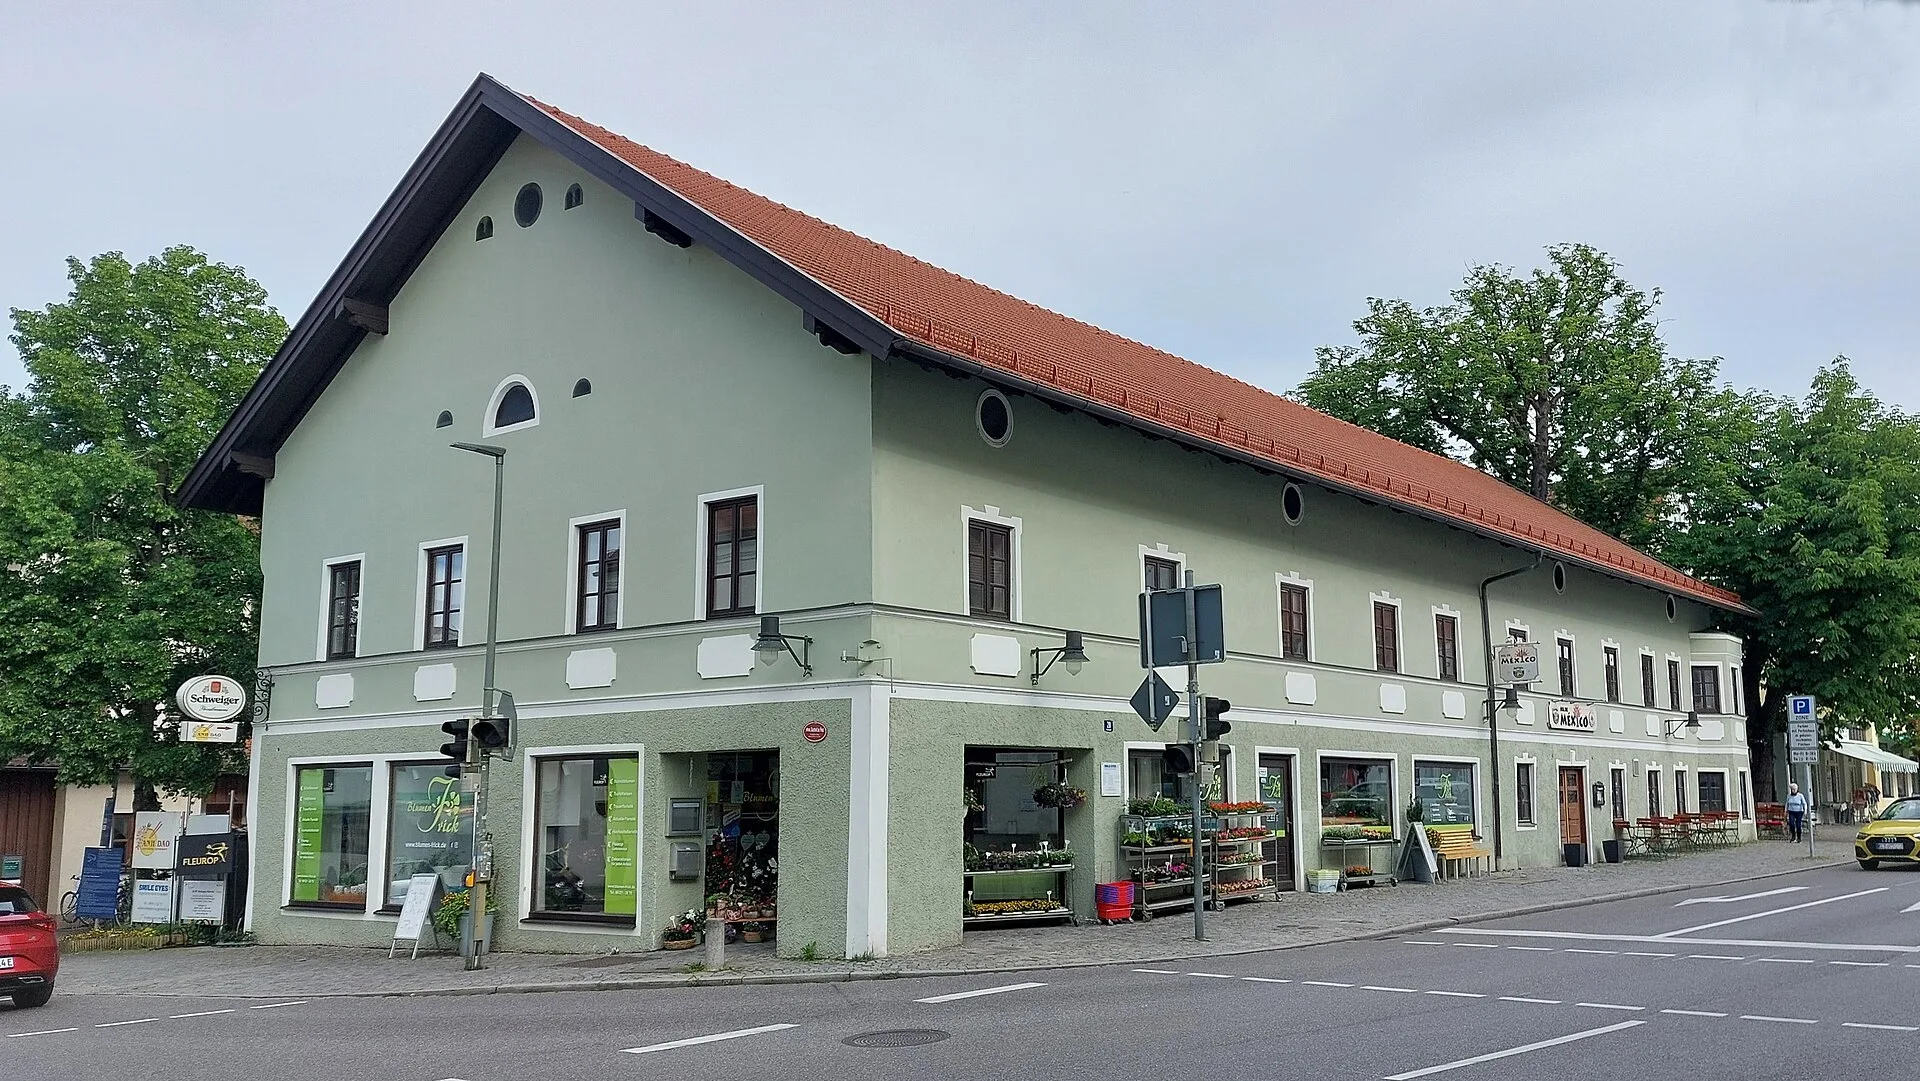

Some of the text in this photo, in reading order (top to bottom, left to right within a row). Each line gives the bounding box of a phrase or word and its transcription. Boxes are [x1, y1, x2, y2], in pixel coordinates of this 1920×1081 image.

[190, 694, 239, 706] Schweiger
[743, 791, 773, 802] Blumen
[407, 801, 432, 812] Blumen
[182, 856, 219, 866] FLEUROP
